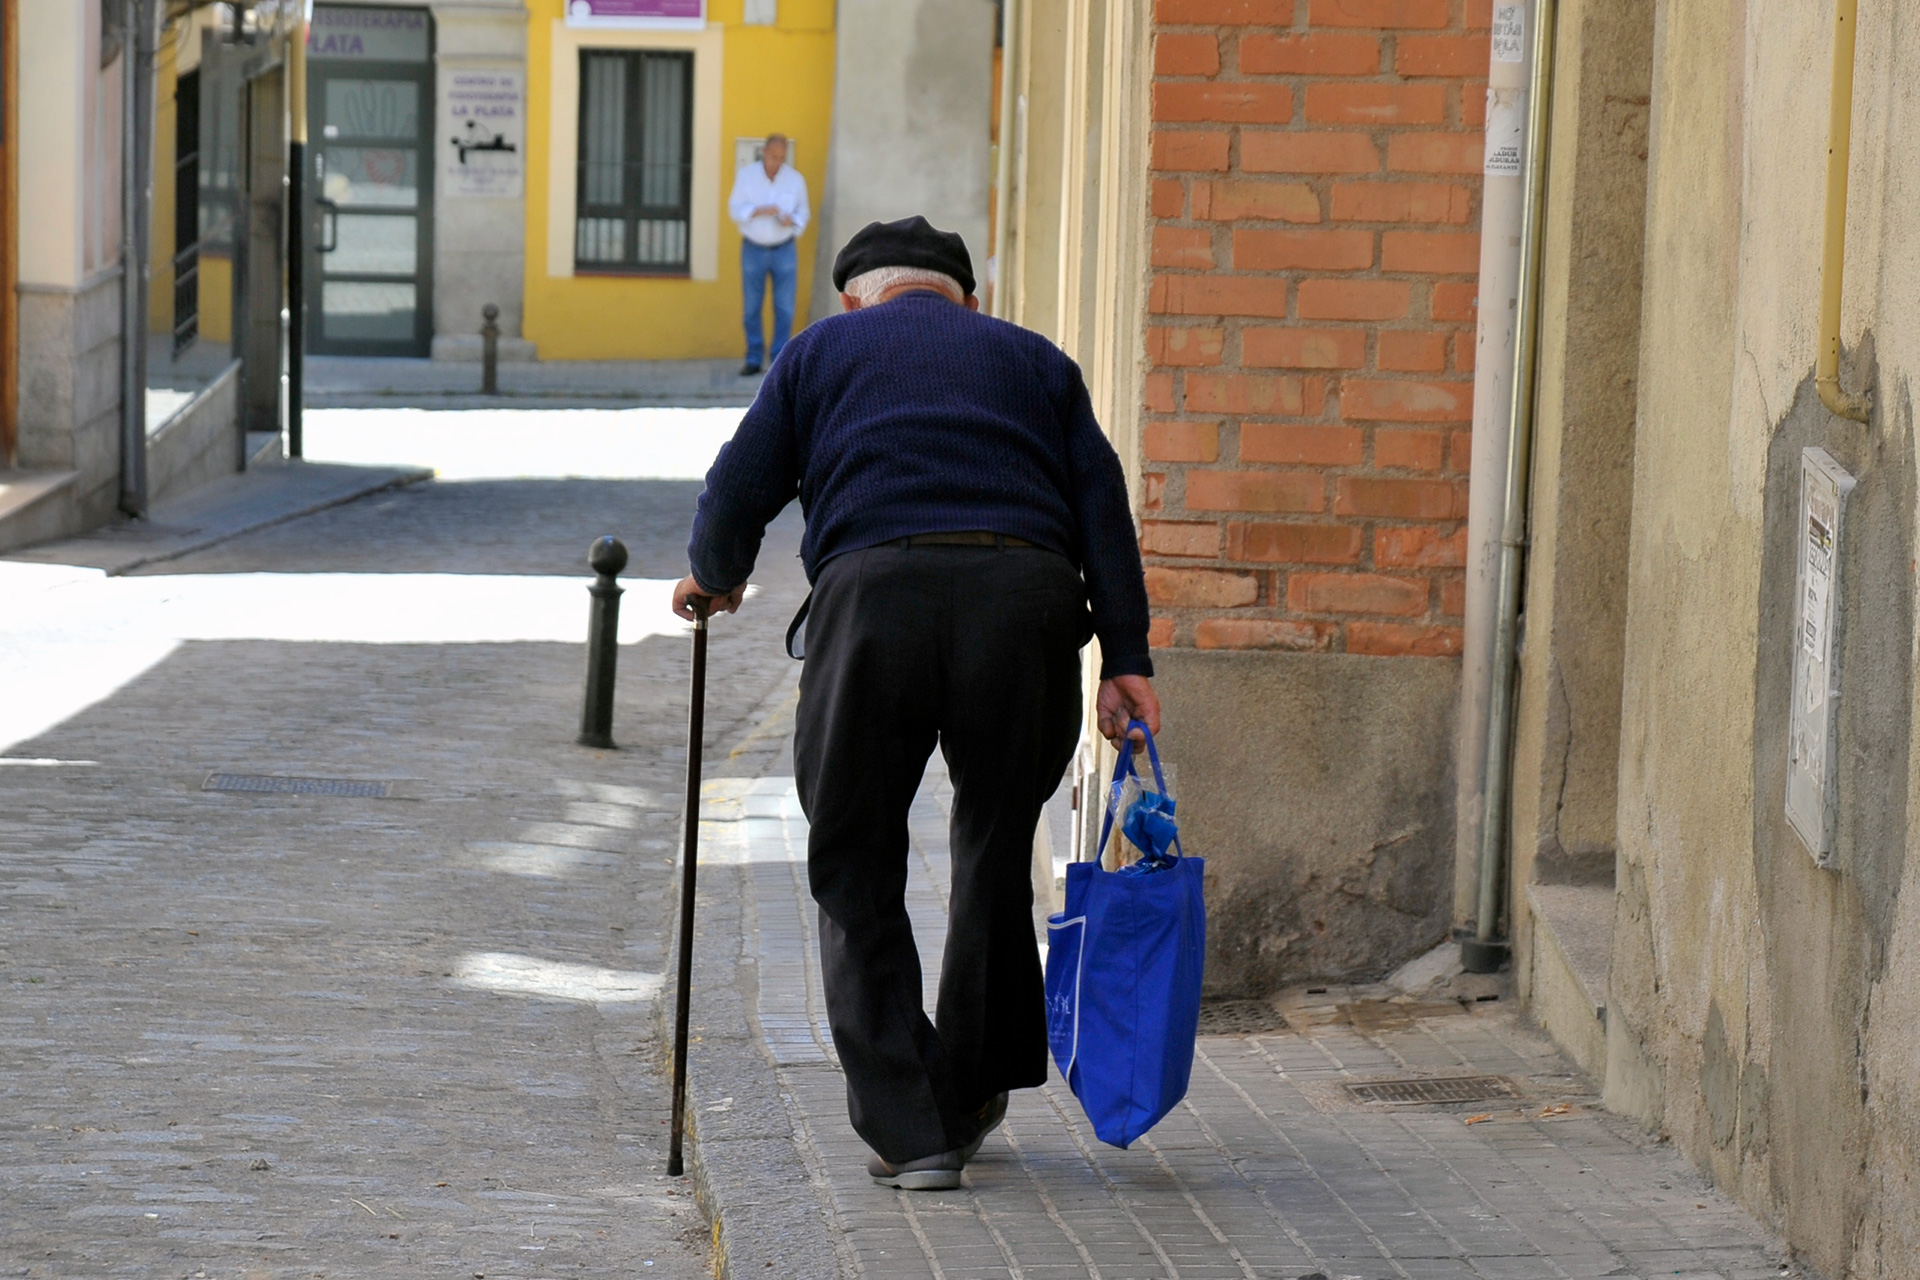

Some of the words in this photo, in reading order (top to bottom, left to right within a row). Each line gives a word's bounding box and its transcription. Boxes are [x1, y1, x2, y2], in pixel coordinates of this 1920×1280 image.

[314, 12, 424, 28] ISIOTERAPIA
[309, 33, 365, 53] LATA
[452, 105, 468, 116] LA
[474, 105, 516, 117] PLATA
